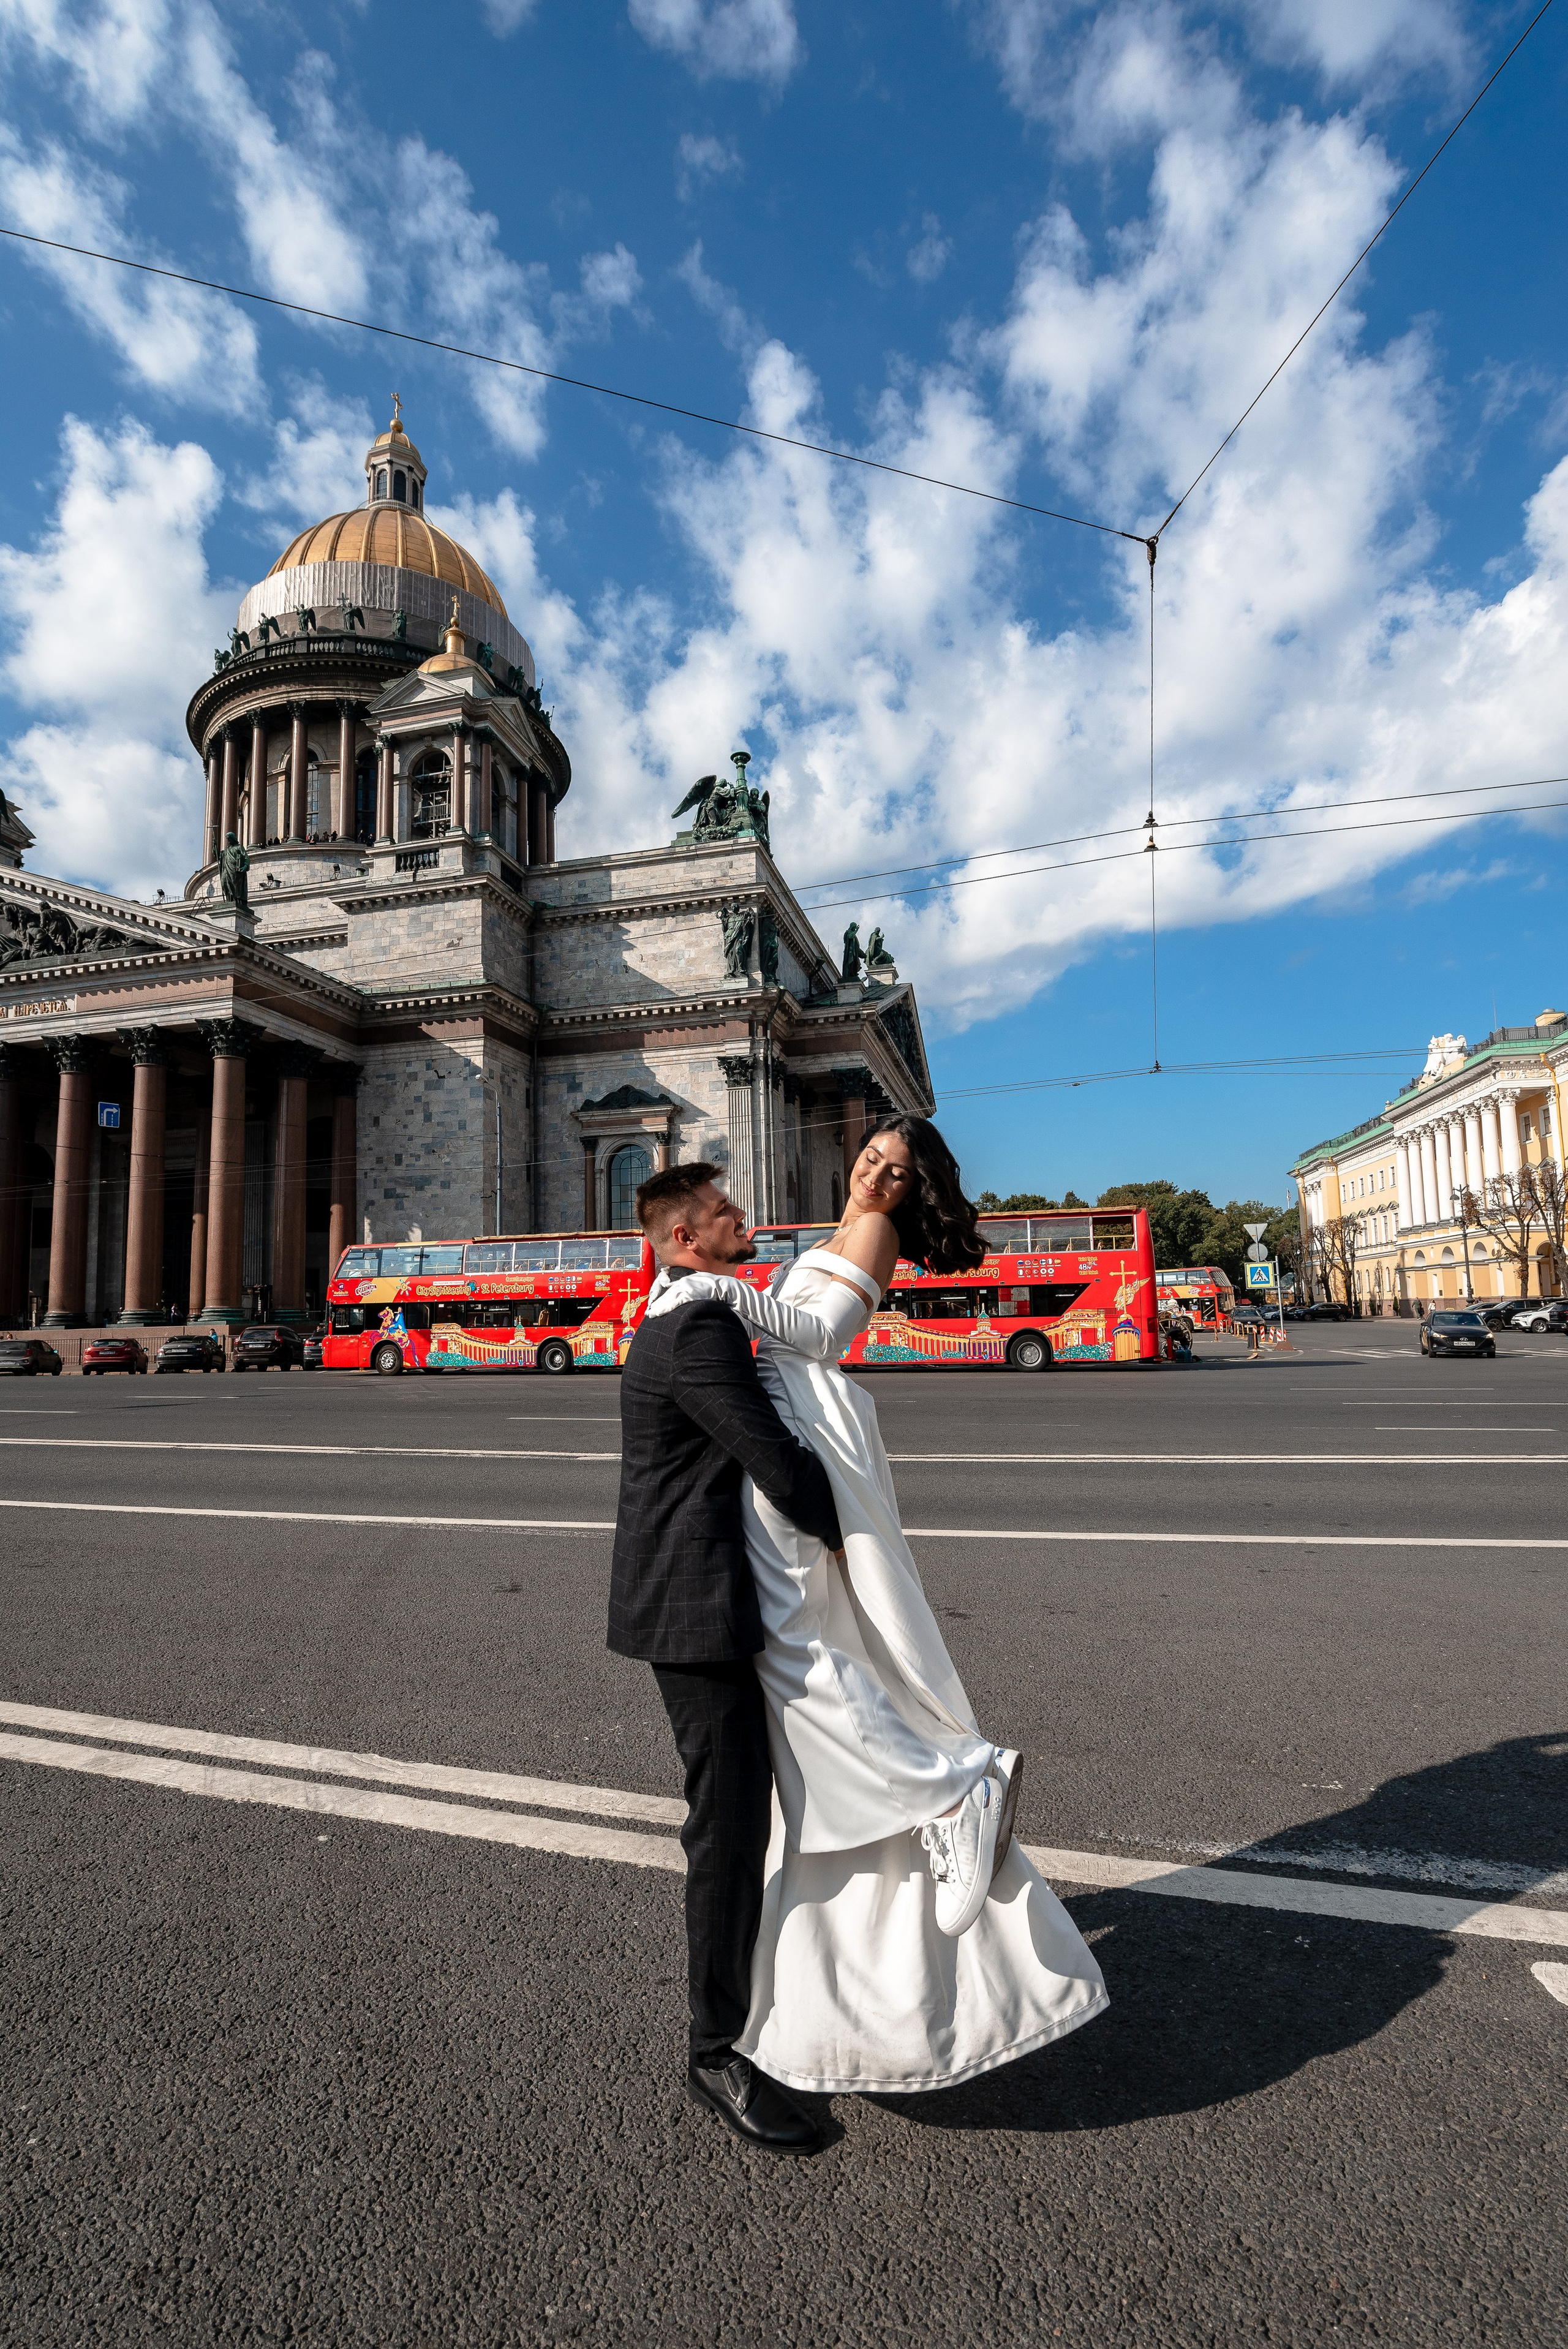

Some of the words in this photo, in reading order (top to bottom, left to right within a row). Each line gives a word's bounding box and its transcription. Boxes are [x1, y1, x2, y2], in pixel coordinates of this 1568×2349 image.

[358, 1285, 375, 1294] OFFICIAL
[481, 1283, 490, 1294] St
[491, 1283, 534, 1294] Petersburg
